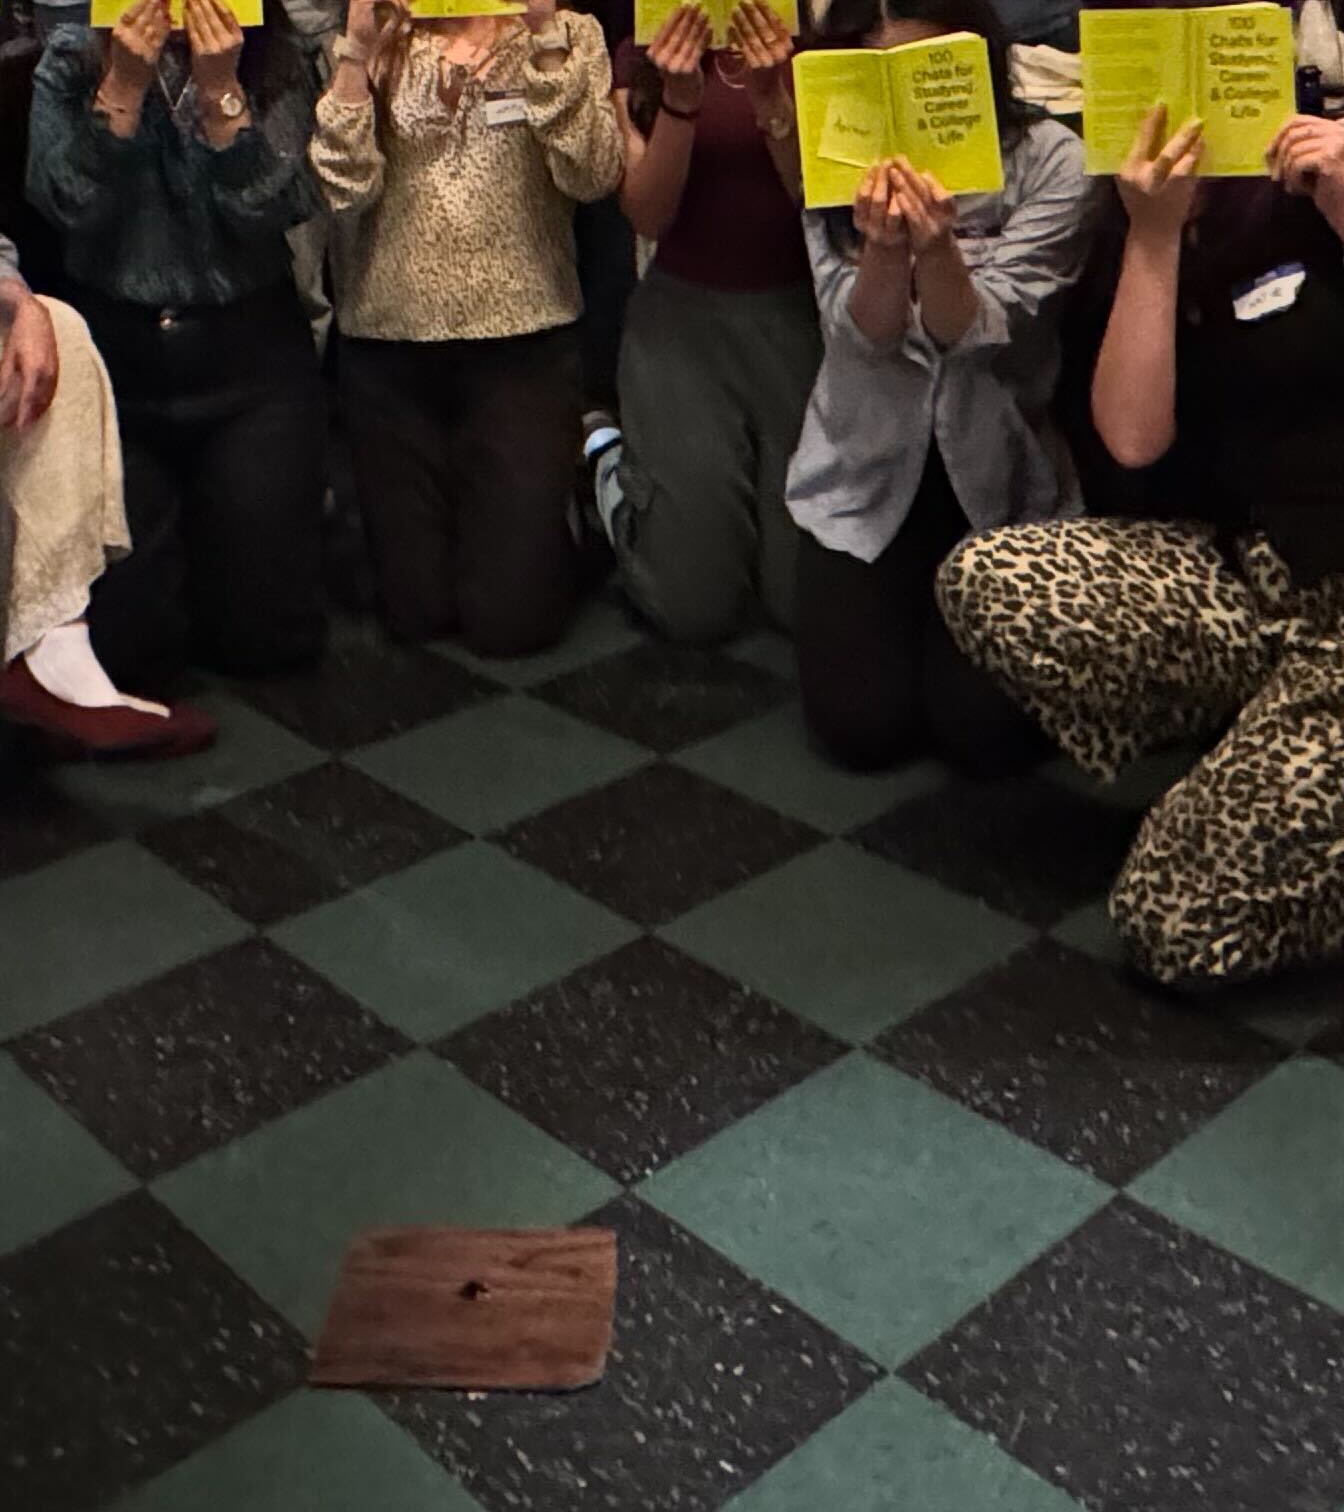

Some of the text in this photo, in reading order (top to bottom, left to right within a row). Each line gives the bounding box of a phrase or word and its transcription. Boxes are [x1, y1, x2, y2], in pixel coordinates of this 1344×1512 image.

[928, 48, 954, 65] 100
[912, 63, 974, 84] Chats for
[924, 99, 969, 114] Career
[929, 114, 981, 131] College
[937, 129, 965, 146] Life
